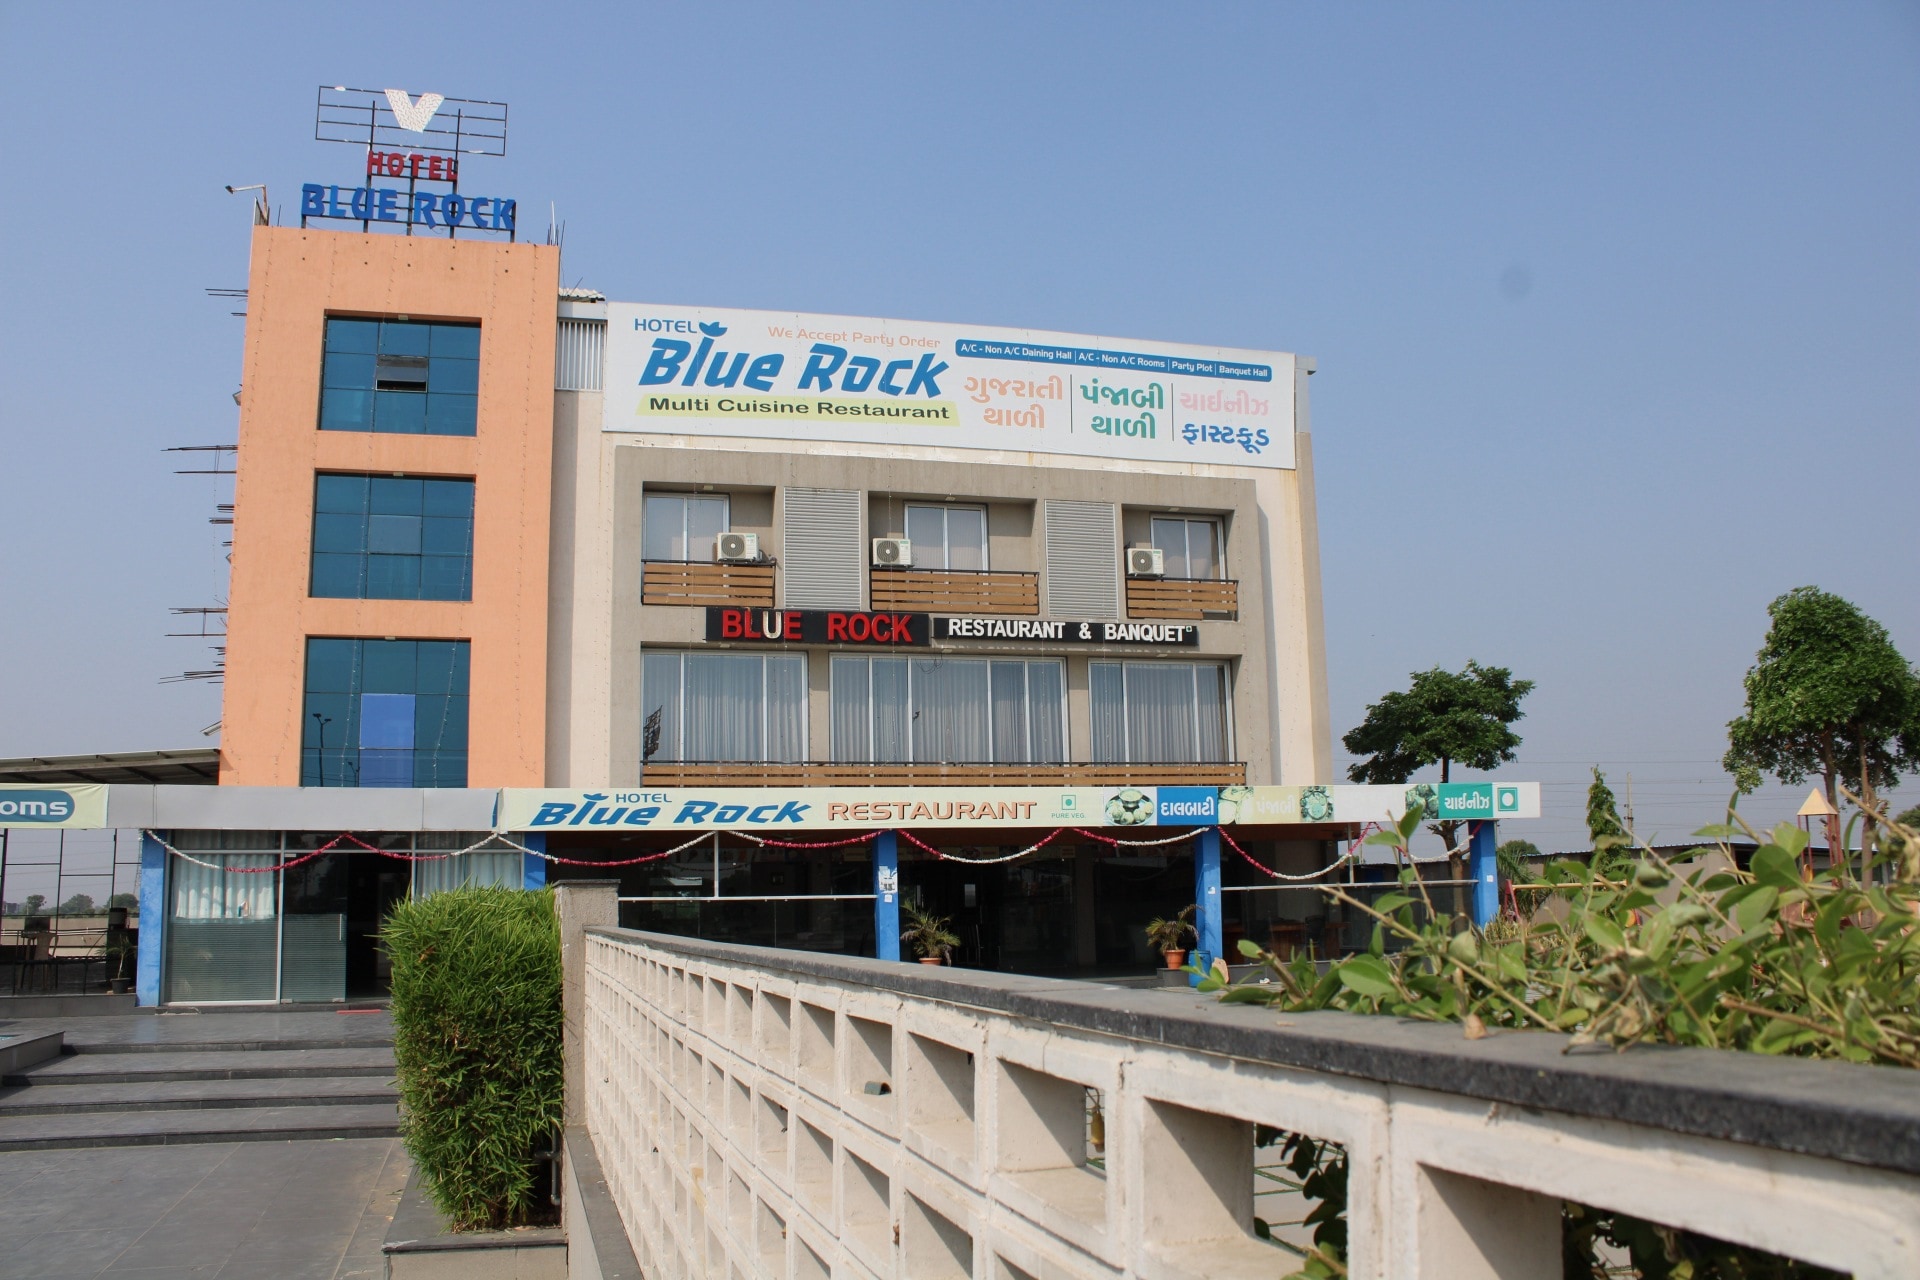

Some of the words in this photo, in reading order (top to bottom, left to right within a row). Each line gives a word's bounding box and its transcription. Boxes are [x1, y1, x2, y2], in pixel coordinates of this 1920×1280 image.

[367, 150, 458, 181] HOTEL
[302, 183, 398, 221] BLUE
[413, 191, 516, 231] ROCK
[635, 318, 697, 334] HOTEL
[768, 326, 793, 338] We
[796, 328, 848, 343] Accept
[852, 332, 895, 348] Party
[899, 335, 940, 348] Order
[638, 336, 784, 392] Blue
[797, 343, 949, 398] Rock
[961, 343, 977, 353] A/C
[985, 345, 1002, 354] Non
[1004, 346, 1020, 356] A/C
[1022, 348, 1054, 359] Daining
[1056, 350, 1072, 360] Hall
[1079, 352, 1094, 361] A/C
[1101, 354, 1118, 364] Non
[1120, 355, 1135, 365] A/C
[1137, 357, 1165, 368] Rooms
[1171, 360, 1194, 372] Party
[1197, 363, 1213, 372] Plot
[1219, 365, 1251, 376] Banquet
[1253, 368, 1268, 377] Hall
[963, 375, 1063, 403] ગુજરાતી
[1080, 377, 1164, 409] પંજાબી
[650, 397, 709, 411] Multi
[717, 399, 809, 413] Cuisine
[817, 401, 949, 418] Restaurant
[983, 403, 1045, 429] થાળી
[1090, 412, 1156, 439] થાળી
[1182, 423, 1270, 454] ફાસ્ટફૂડ
[722, 611, 803, 639] BLUE
[827, 613, 914, 642] ROCK
[949, 619, 1066, 639] RESTAURANT
[1078, 623, 1093, 639] &
[1104, 624, 1186, 642] BANQUET
[615, 793, 672, 803] HOTEL
[1161, 796, 1214, 816] દાલબાટી
[529, 800, 661, 826] Blue
[673, 801, 812, 824] Rock
[828, 802, 1037, 821] RESTAURANT
